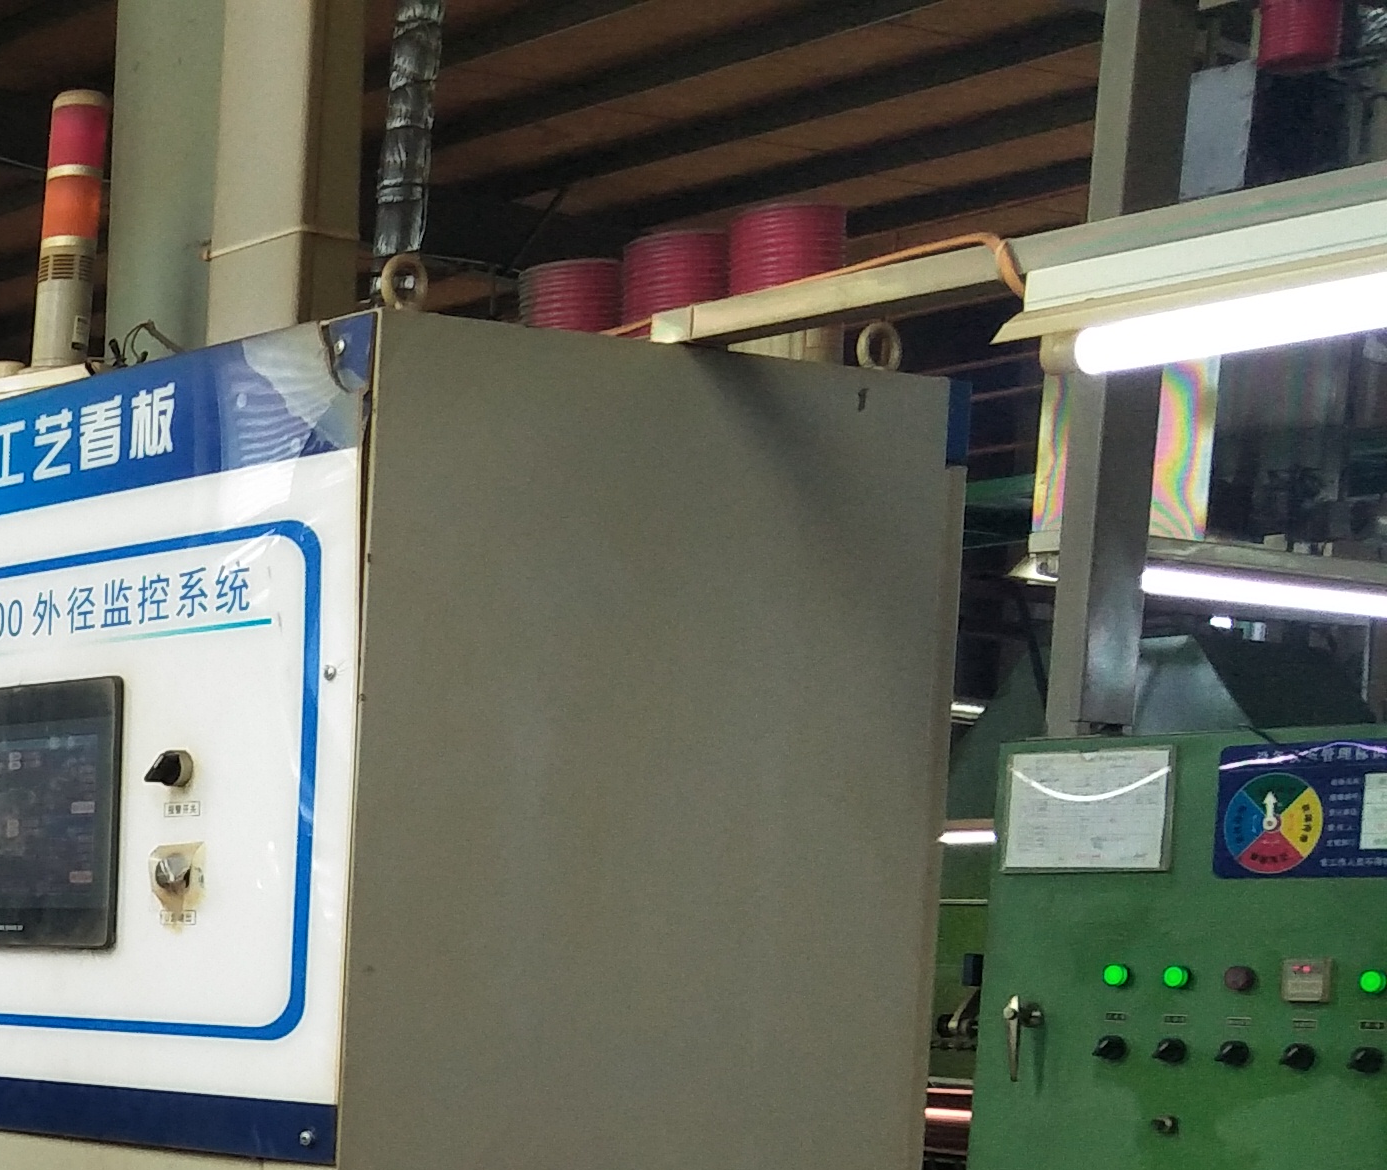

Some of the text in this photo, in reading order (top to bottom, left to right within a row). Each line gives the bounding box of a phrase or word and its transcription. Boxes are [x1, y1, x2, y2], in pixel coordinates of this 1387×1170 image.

[31, 562, 252, 637] 外径监控系统
